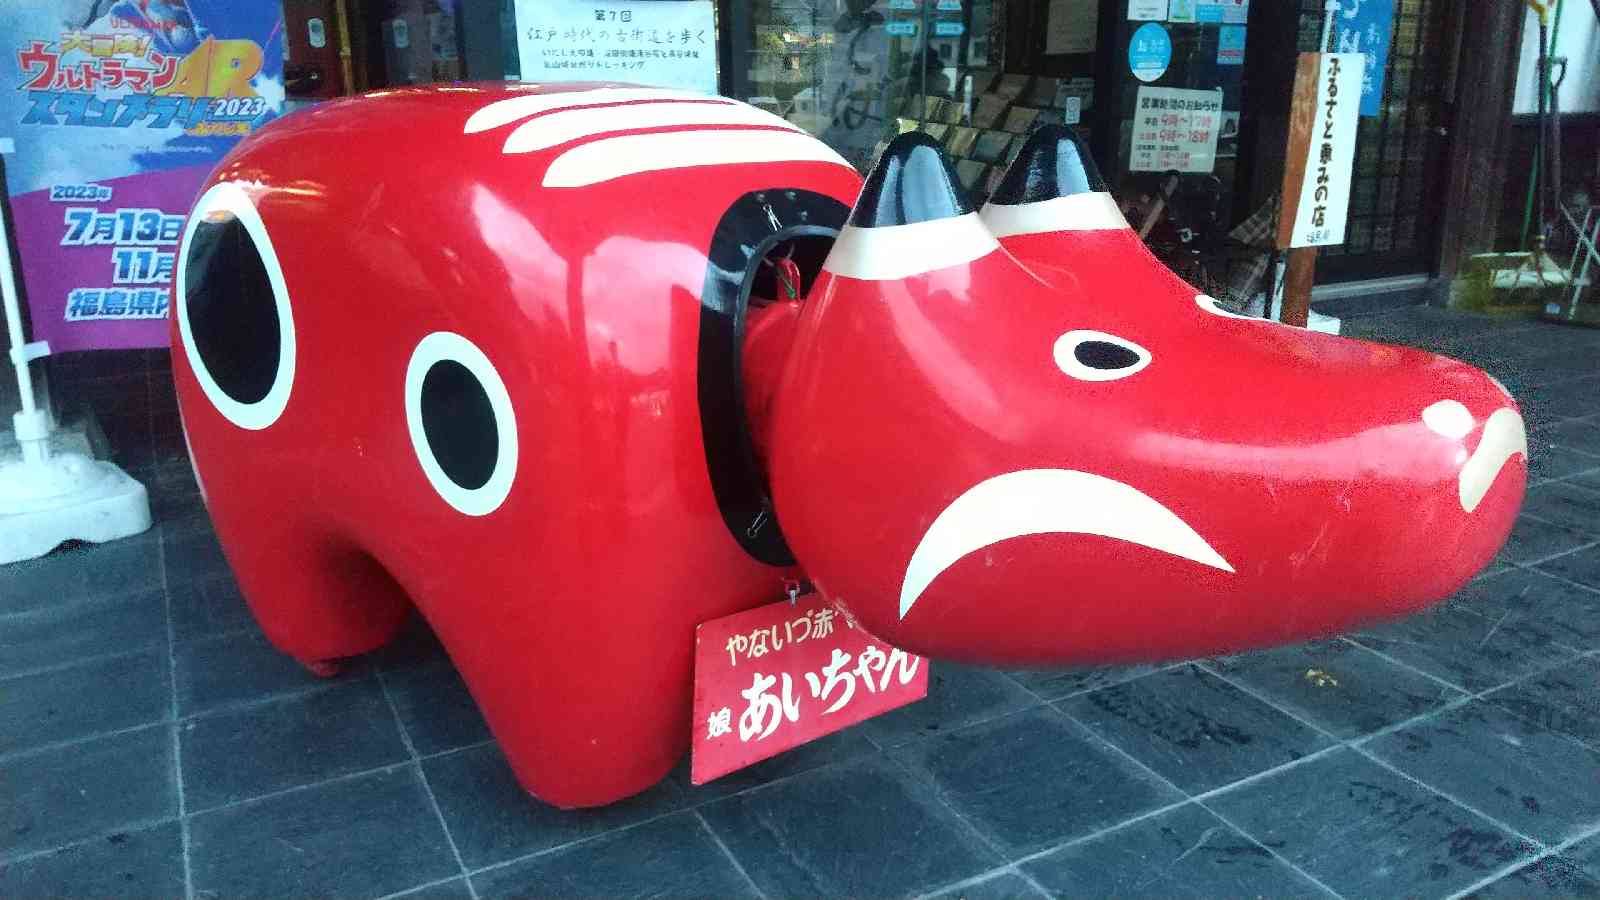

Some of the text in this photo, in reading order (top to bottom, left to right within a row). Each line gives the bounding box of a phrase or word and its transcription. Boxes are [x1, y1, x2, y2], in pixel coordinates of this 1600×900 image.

[595, 9, 633, 23] 第7回
[52, 185, 111, 200] 2023年
[706, 646, 920, 742] 娘 あいちゃん
